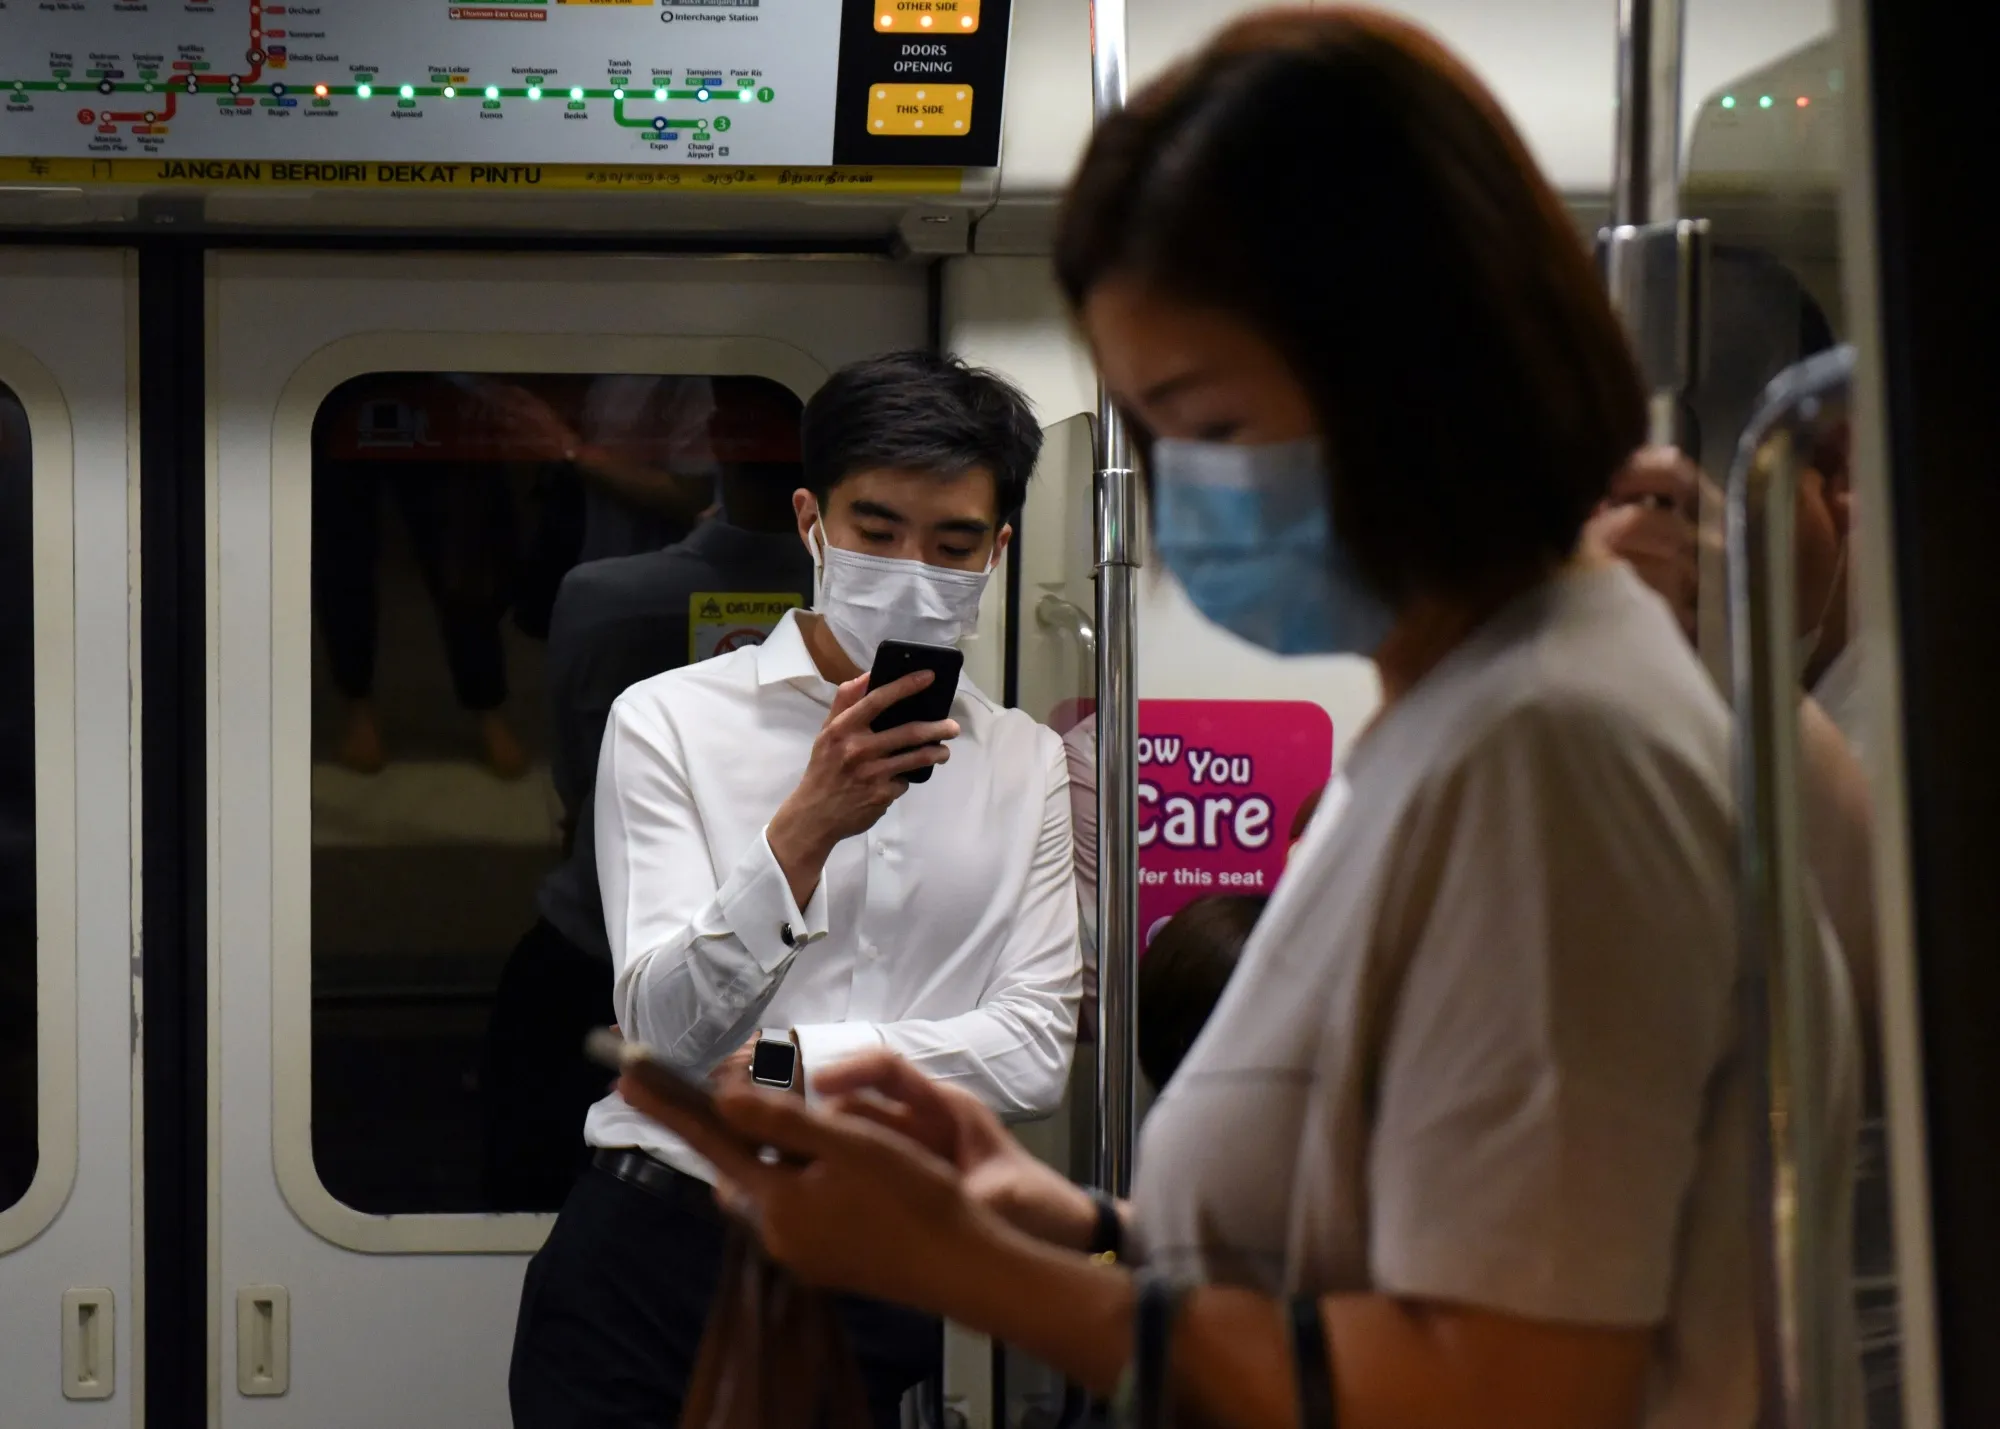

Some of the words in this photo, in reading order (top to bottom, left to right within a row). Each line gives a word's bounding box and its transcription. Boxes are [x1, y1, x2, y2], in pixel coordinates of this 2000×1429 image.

[897, 3, 932, 11] OTHER
[935, 3, 959, 11] SIDE
[675, 13, 726, 22] Interchange
[728, 13, 758, 21] Station
[901, 44, 947, 56] DOORS
[608, 59, 631, 67] Tanah
[893, 61, 953, 72] OPENING
[512, 67, 557, 75] Kembangan
[762, 90, 769, 100] 1
[896, 105, 919, 114] THIS
[922, 105, 944, 114] SIDE
[718, 118, 726, 129] 3
[650, 143, 668, 151] Expo
[688, 143, 714, 151] Changi
[687, 151, 714, 159] Airport
[157, 161, 260, 180] JANGAN
[271, 163, 366, 181] BERDIRI
[377, 164, 460, 183] DEKAT
[470, 165, 541, 185] PINTU
[1138, 738, 1181, 764] ow
[1187, 750, 1250, 783] You
[1138, 783, 1270, 847] Care
[1138, 868, 1168, 885] fer
[1173, 868, 1212, 885] this
[1218, 869, 1264, 886] seat
